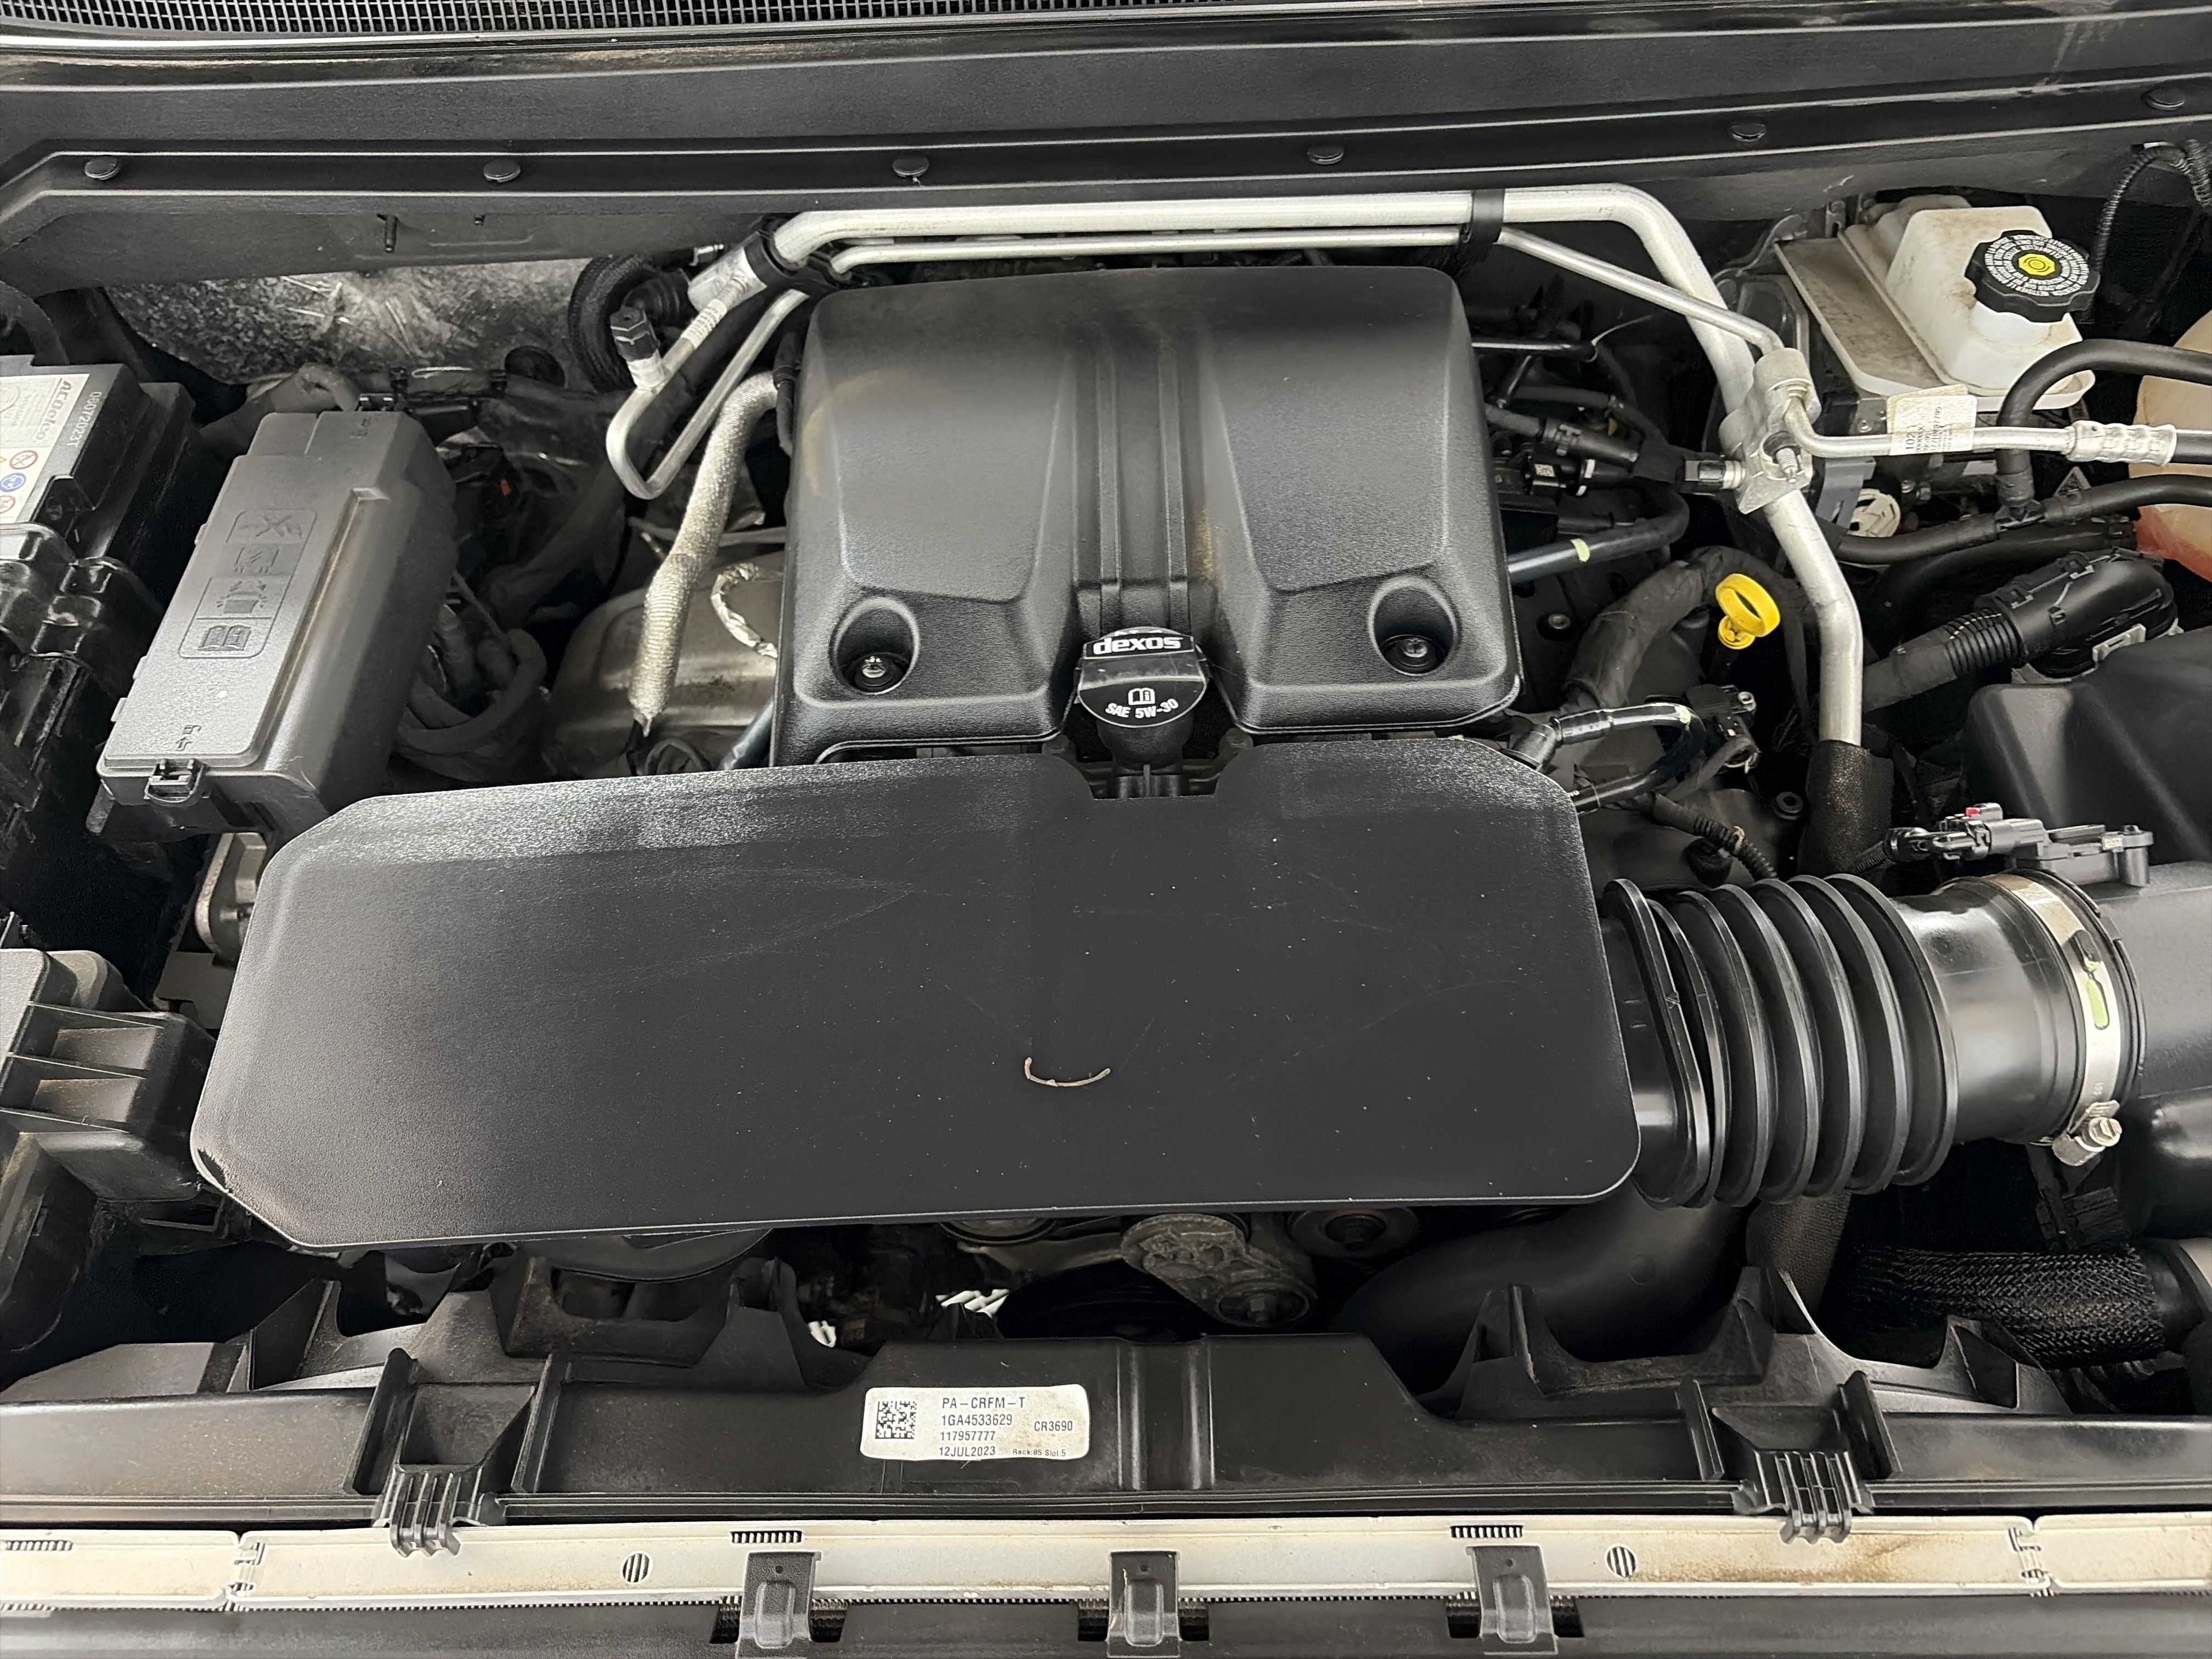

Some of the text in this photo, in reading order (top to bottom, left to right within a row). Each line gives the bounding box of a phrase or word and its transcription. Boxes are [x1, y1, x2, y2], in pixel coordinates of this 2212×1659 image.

[1093, 637, 1183, 655] dexos
[1105, 698, 1178, 719] SAE 5W-30
[941, 1414, 1013, 1426] 1GA4533629
[1034, 1420, 1073, 1432] CR3690
[940, 1431, 996, 1441] 117957777
[939, 1446, 996, 1457] 12JUL2023
